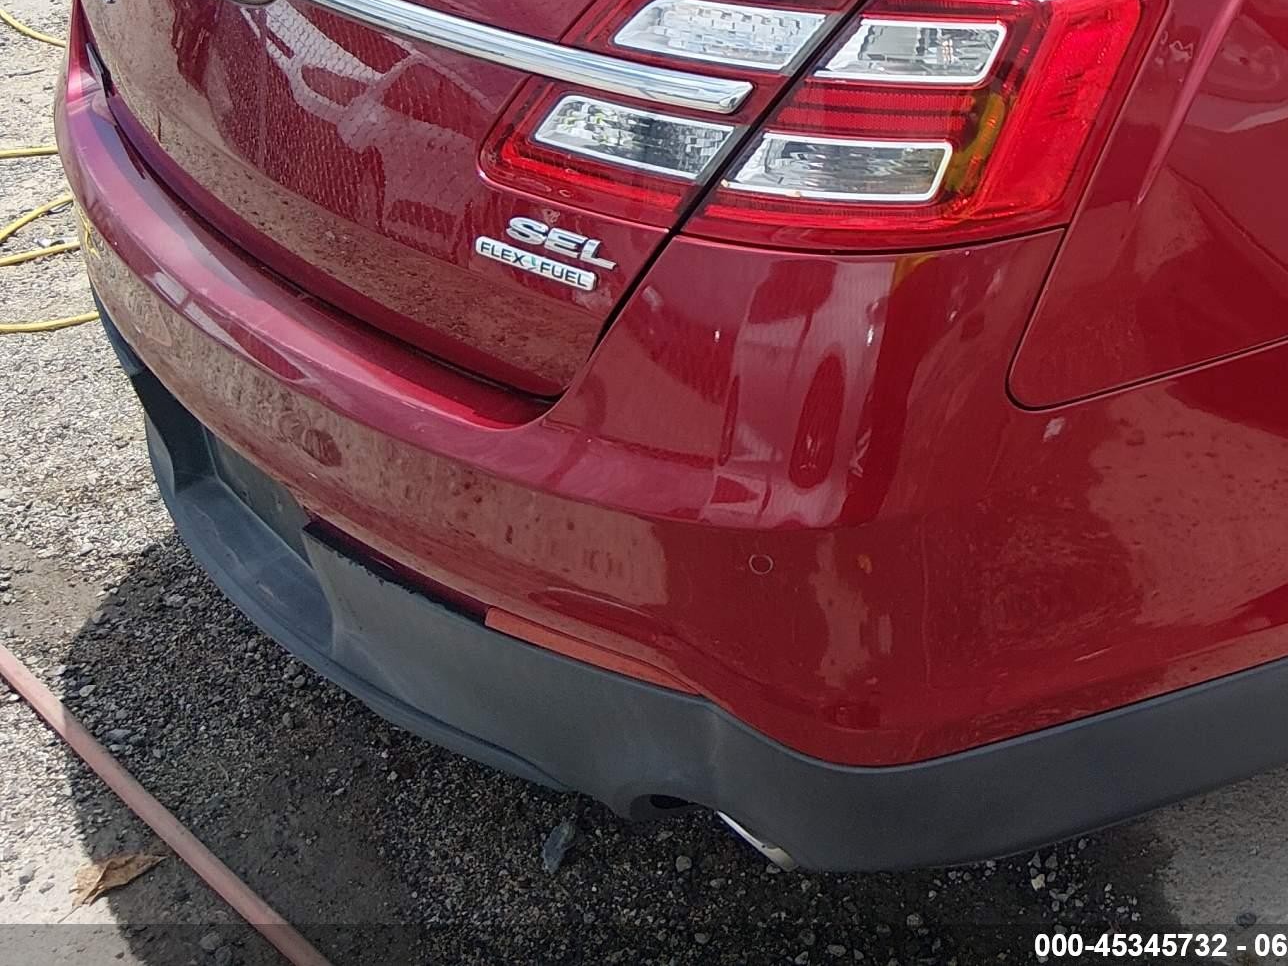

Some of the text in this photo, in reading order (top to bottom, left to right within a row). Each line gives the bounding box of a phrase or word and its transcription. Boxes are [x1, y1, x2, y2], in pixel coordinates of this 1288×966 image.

[480, 240, 587, 287] FLEX FUEL
[506, 216, 617, 270] SEL
